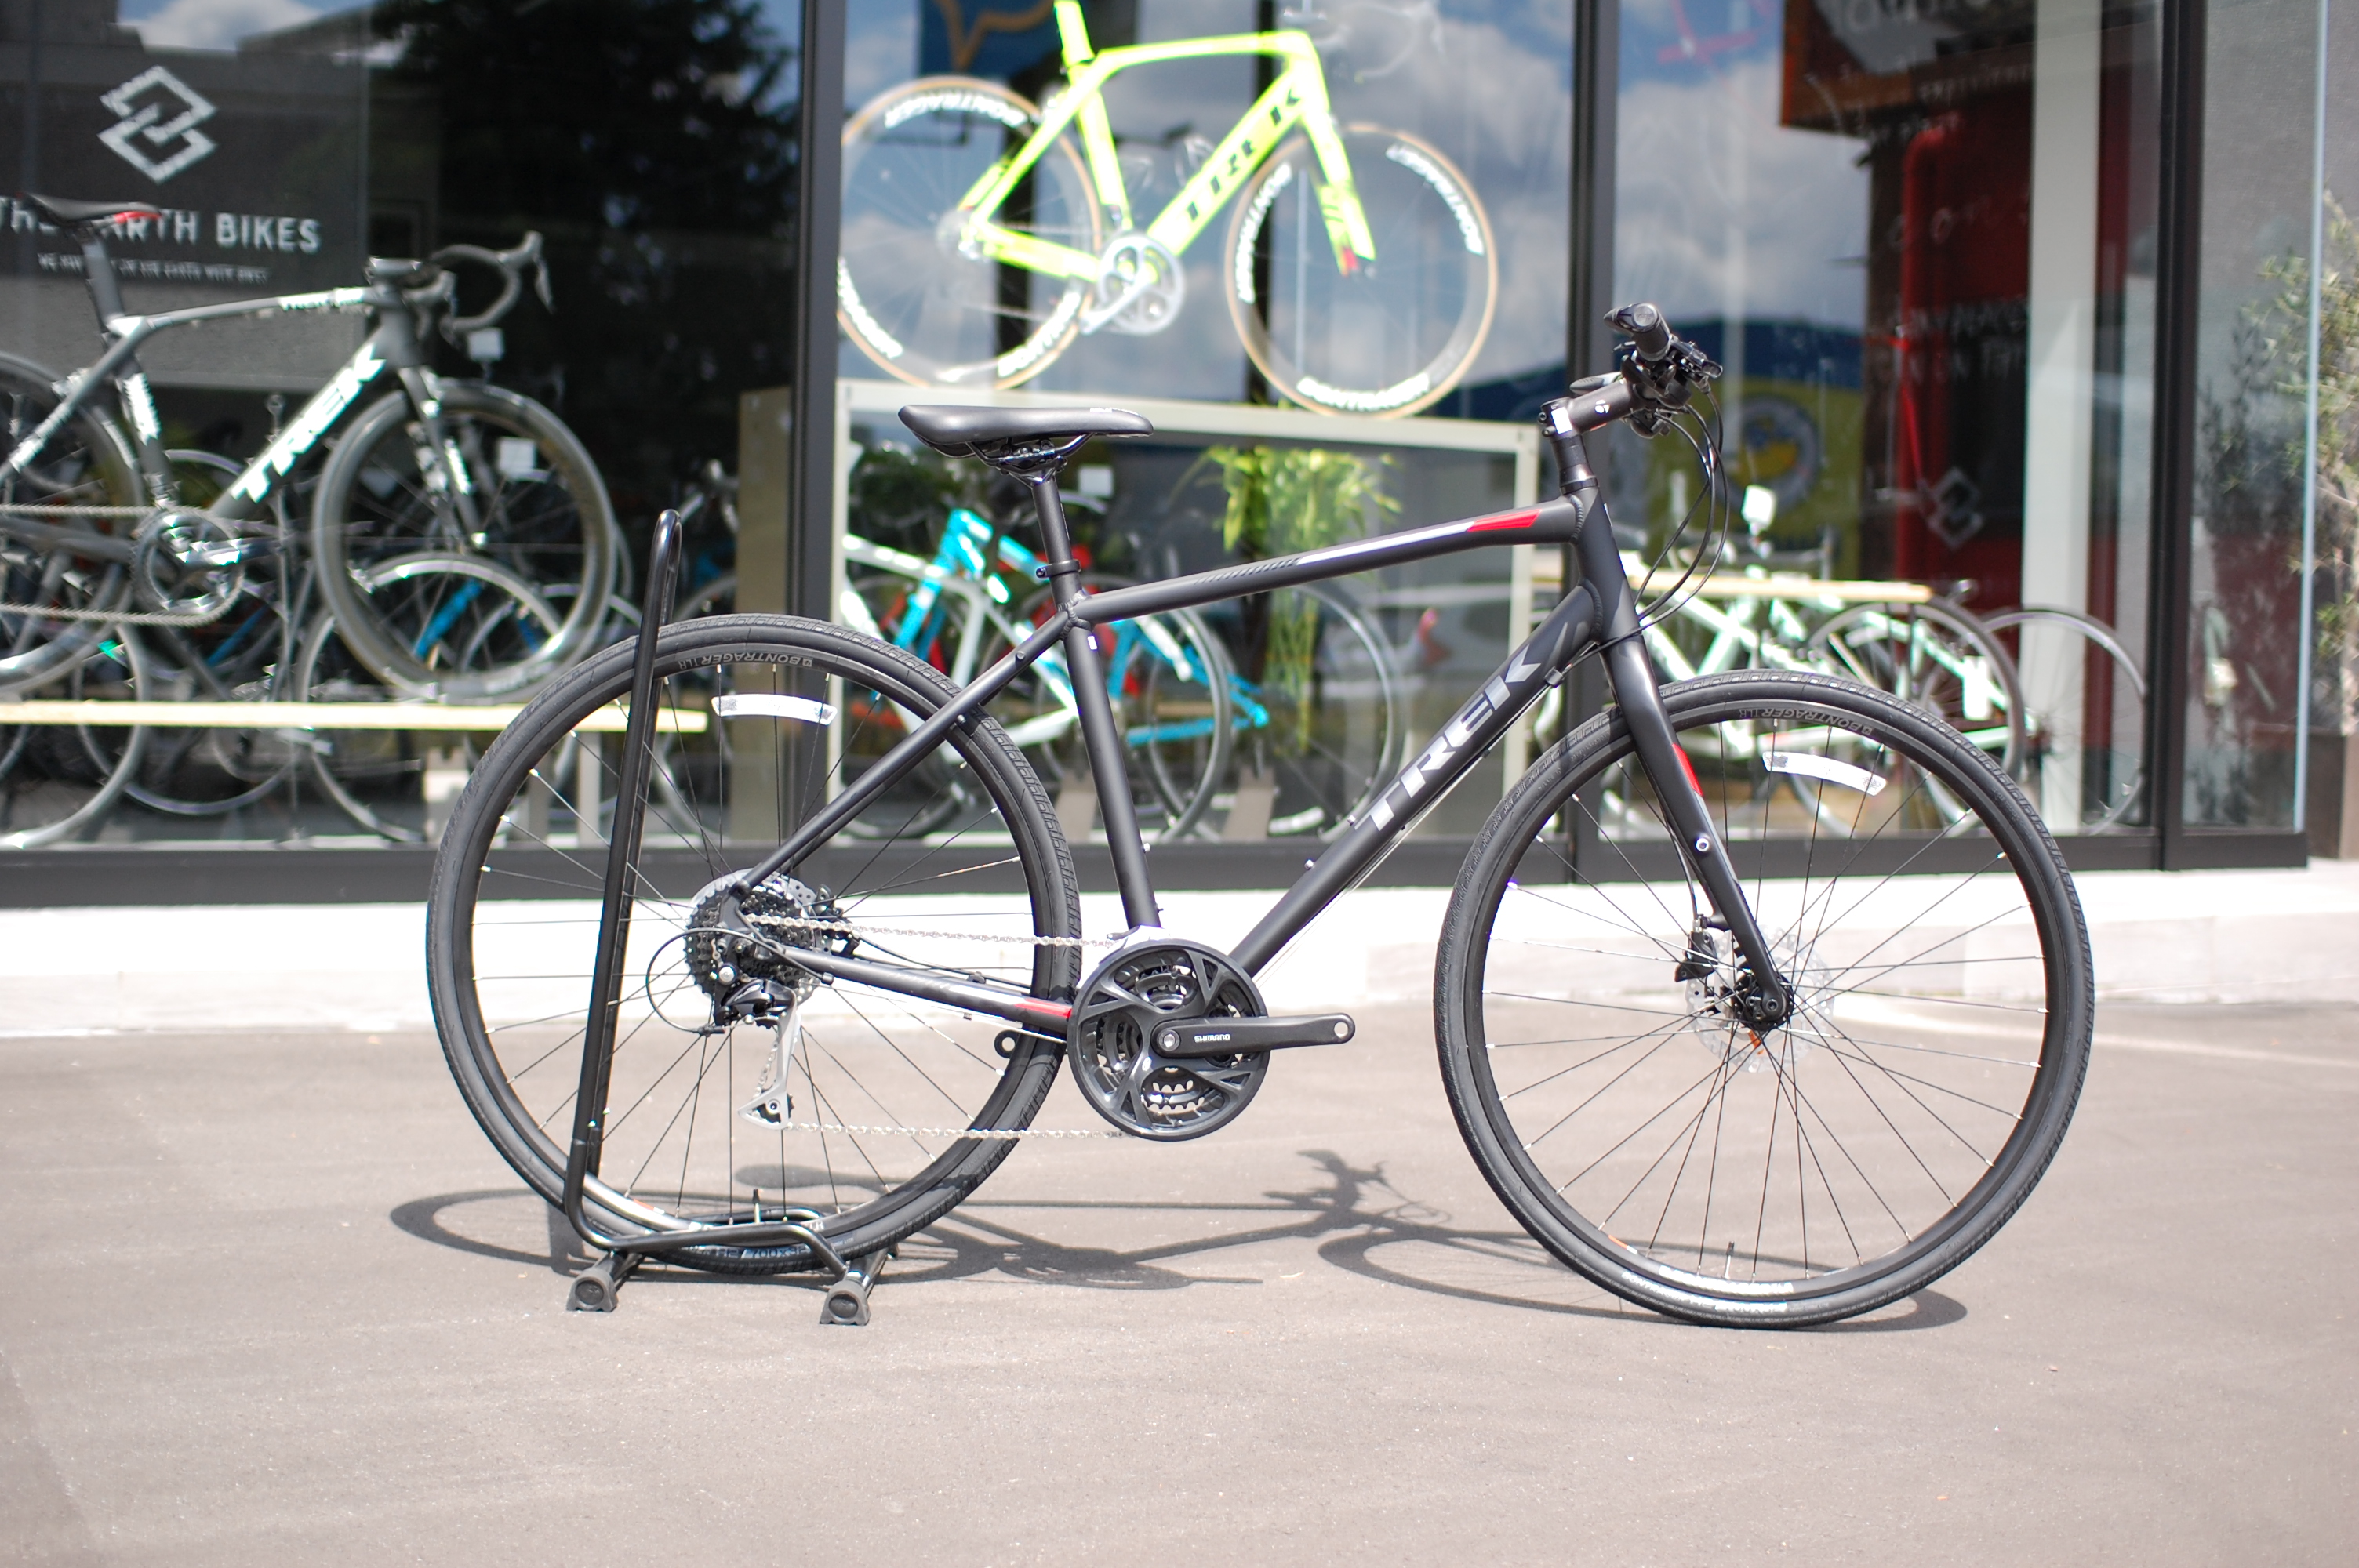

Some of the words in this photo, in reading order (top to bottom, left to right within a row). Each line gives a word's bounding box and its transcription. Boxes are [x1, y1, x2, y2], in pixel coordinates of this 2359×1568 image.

[216, 212, 322, 254] BIKES
[231, 342, 387, 504] TREK
[701, 652, 801, 666] BONTRAGER
[1761, 708, 1863, 731] BONTRAGER
[1354, 644, 1541, 831] TREK
[1194, 1033, 1230, 1043] SHIMANO
